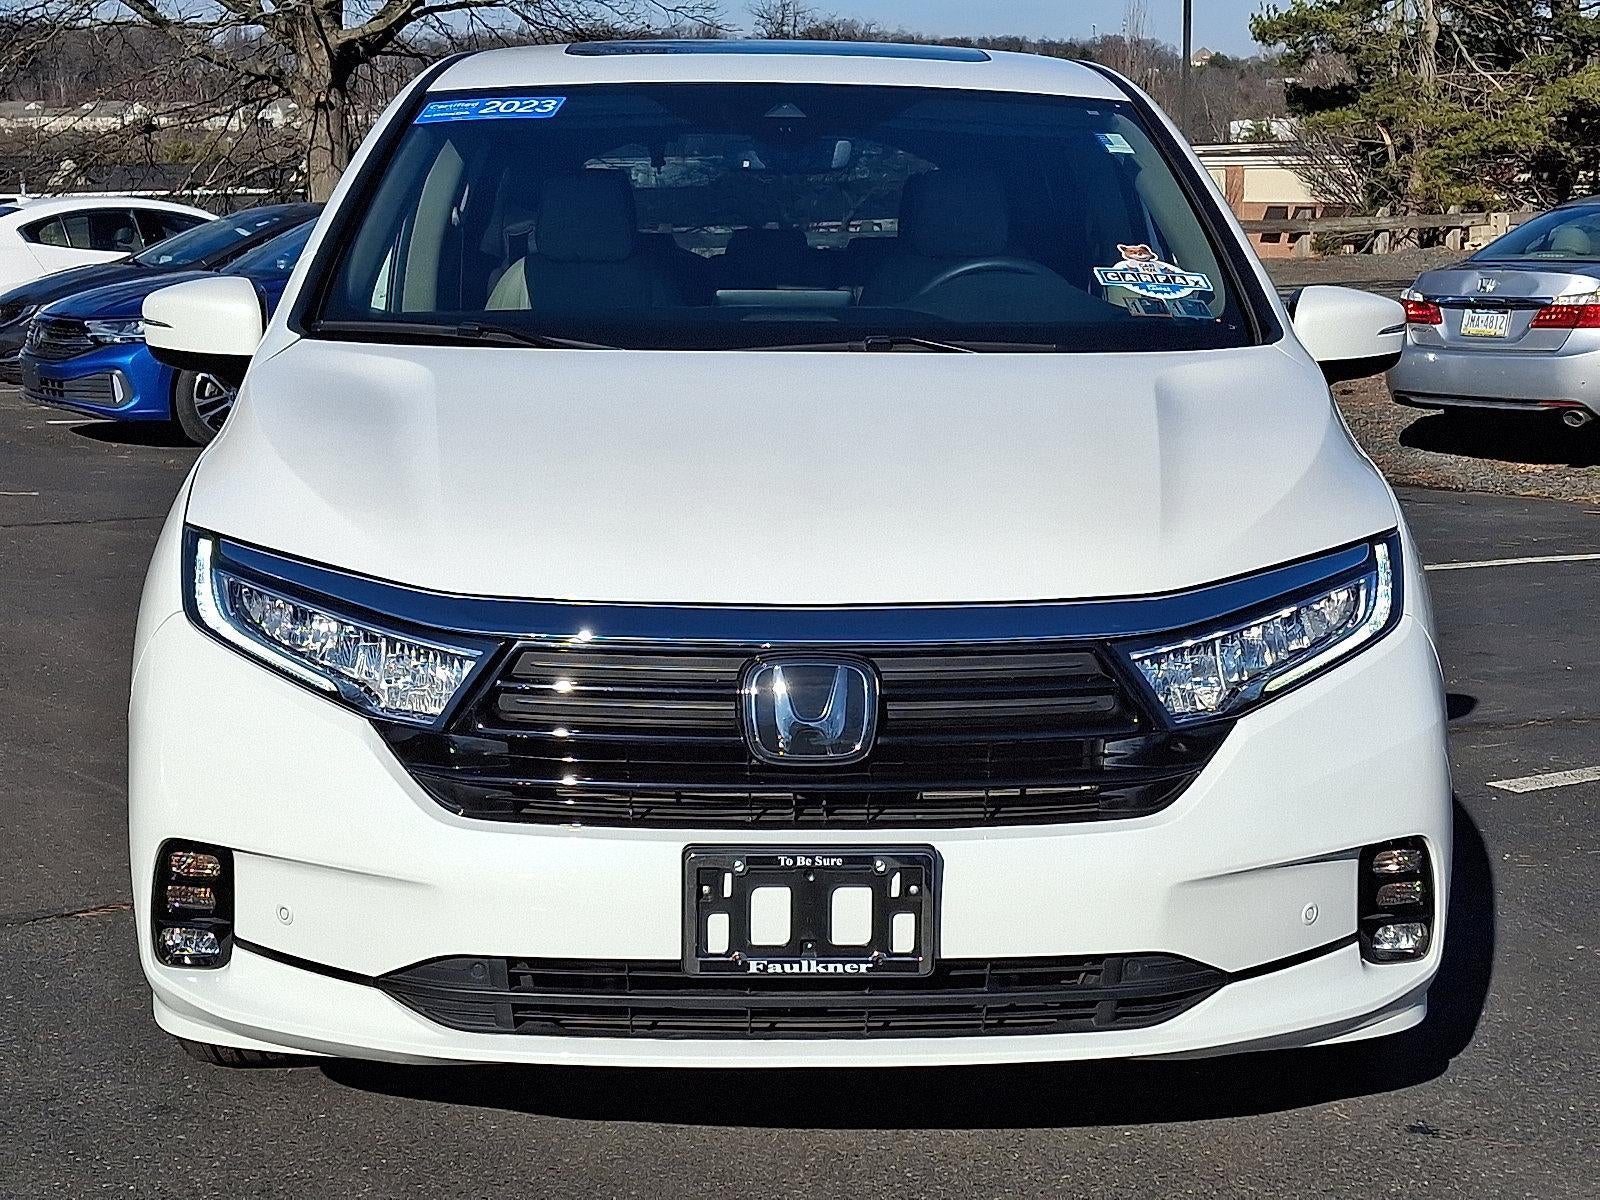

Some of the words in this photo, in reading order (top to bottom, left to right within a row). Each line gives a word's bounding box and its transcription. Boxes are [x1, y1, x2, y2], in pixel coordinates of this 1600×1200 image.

[478, 100, 557, 114] 2023
[1106, 271, 1205, 288] CARFAX
[778, 856, 793, 866] To
[797, 856, 812, 866] Be
[815, 855, 843, 866] Sure
[746, 959, 873, 974] Faulkner
